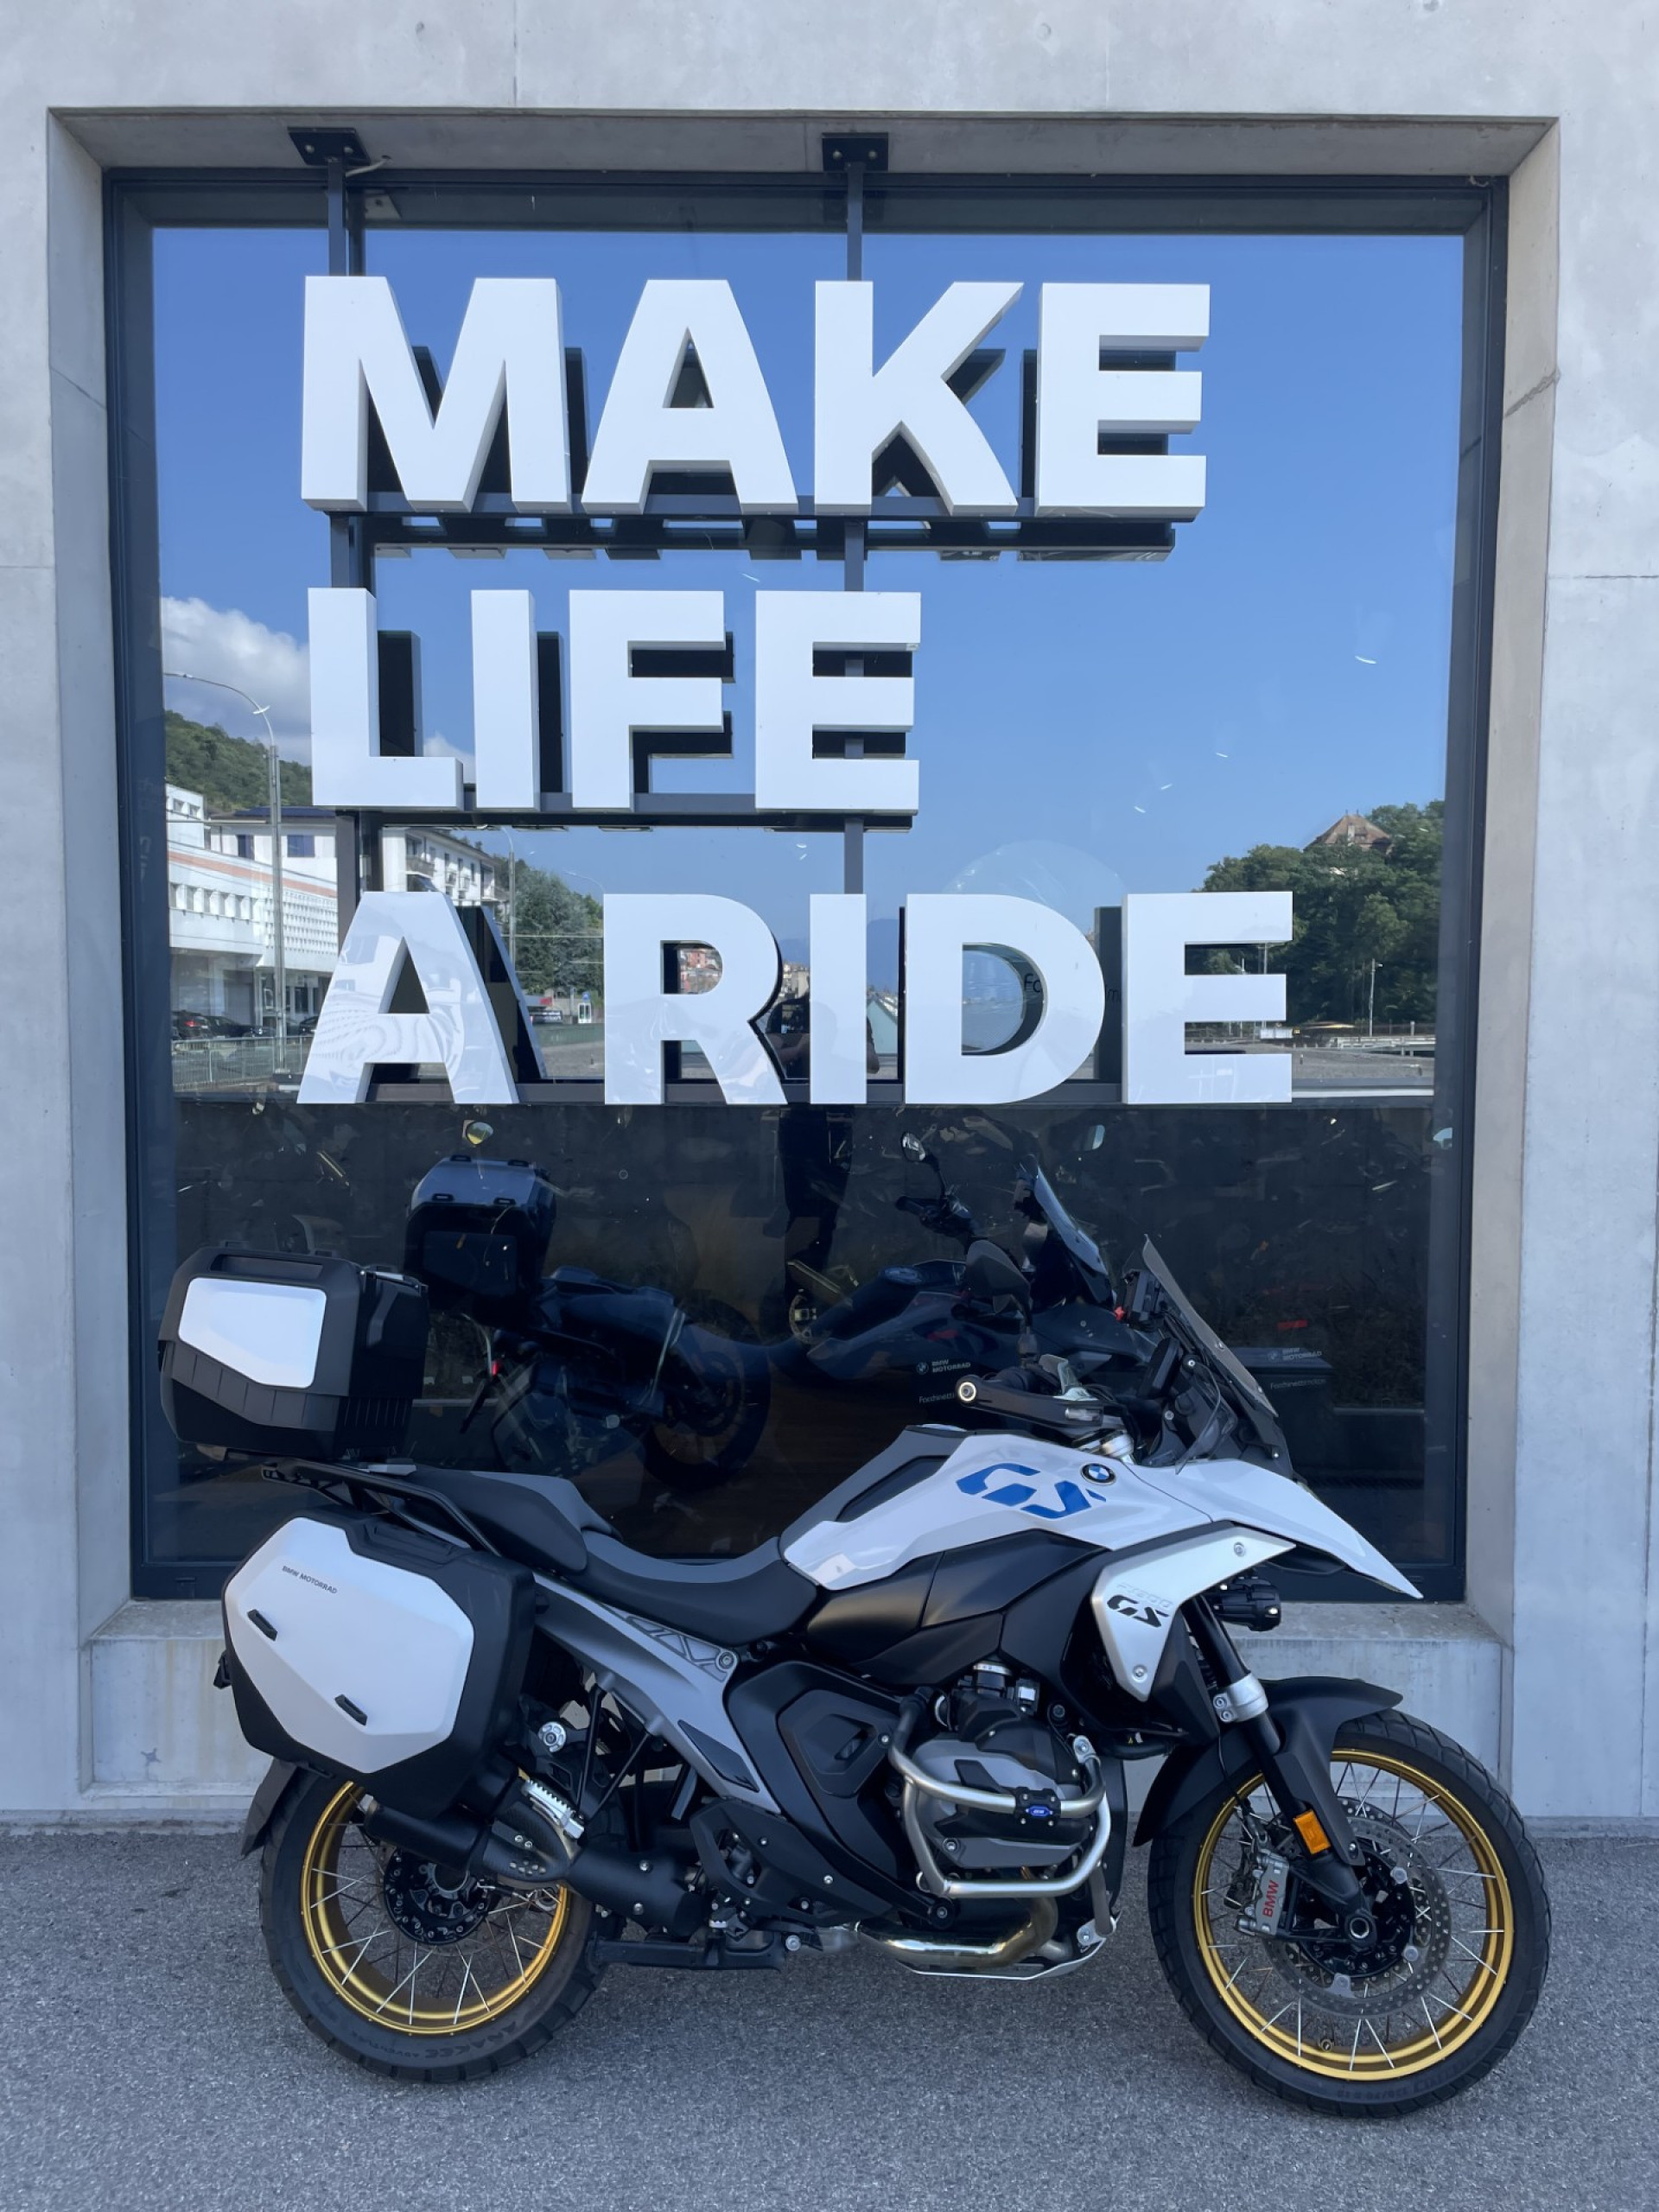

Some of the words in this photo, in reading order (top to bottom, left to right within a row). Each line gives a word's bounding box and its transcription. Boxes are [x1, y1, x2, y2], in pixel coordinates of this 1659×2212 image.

[301, 275, 1211, 513] MAKE
[307, 588, 923, 815] LIFE
[296, 891, 519, 1105] A
[602, 891, 1294, 1106] RIDE
[932, 1363, 971, 1373] MOTORRAD
[282, 1565, 300, 1577] BMW
[299, 1573, 338, 1594] MOTORRAD
[1106, 1593, 1170, 1629] GS
[1262, 1879, 1280, 1918] BMW
